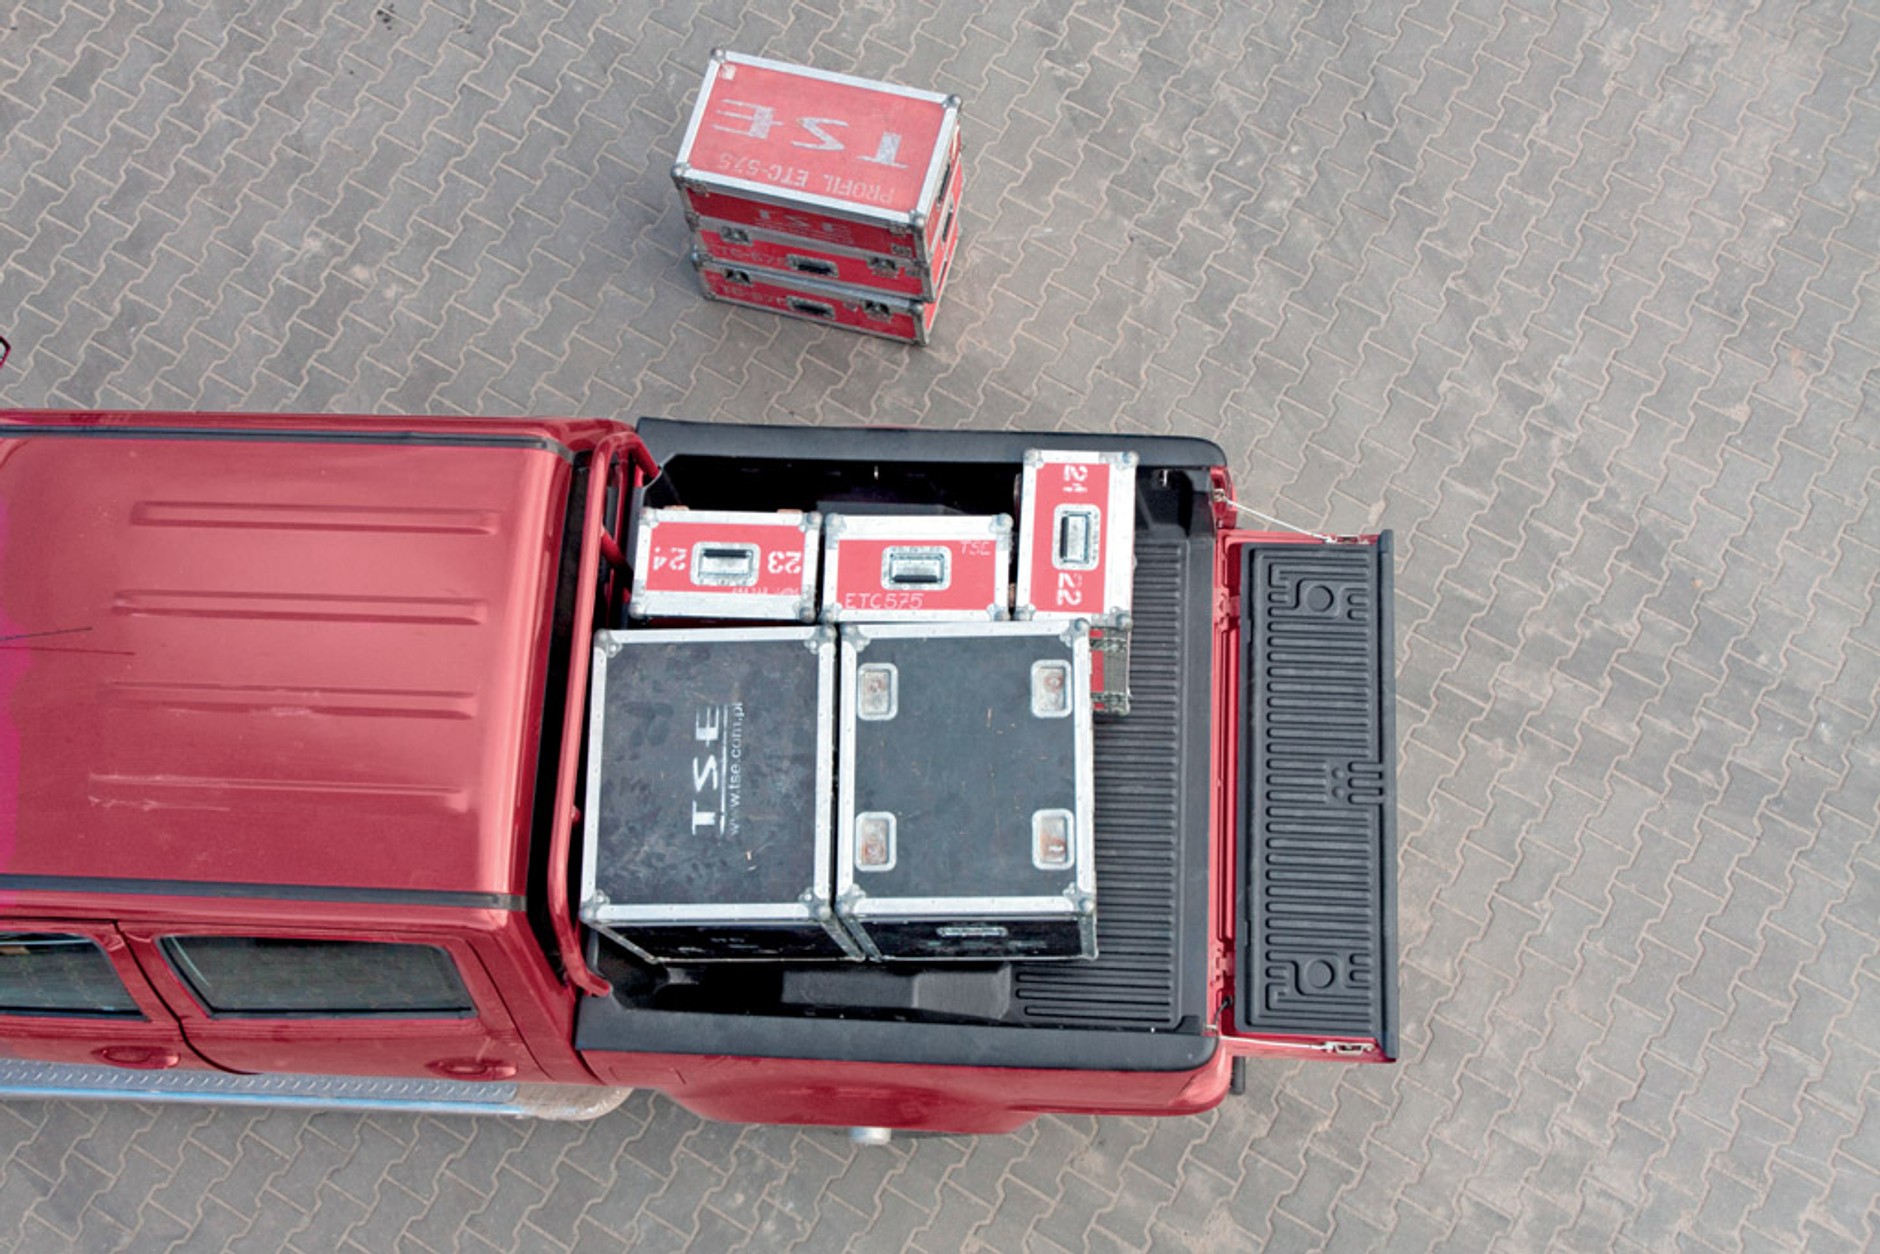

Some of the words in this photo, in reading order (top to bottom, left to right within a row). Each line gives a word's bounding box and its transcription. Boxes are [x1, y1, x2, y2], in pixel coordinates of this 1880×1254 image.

[711, 98, 910, 169] TSE
[716, 152, 809, 187] ETC-575
[822, 174, 895, 204] PROFIL
[652, 546, 687, 571] 24
[767, 550, 802, 574] 23
[960, 540, 991, 556] TSE
[844, 592, 925, 610] ETC575
[1056, 572, 1082, 607] 22
[691, 706, 720, 836] TSE
